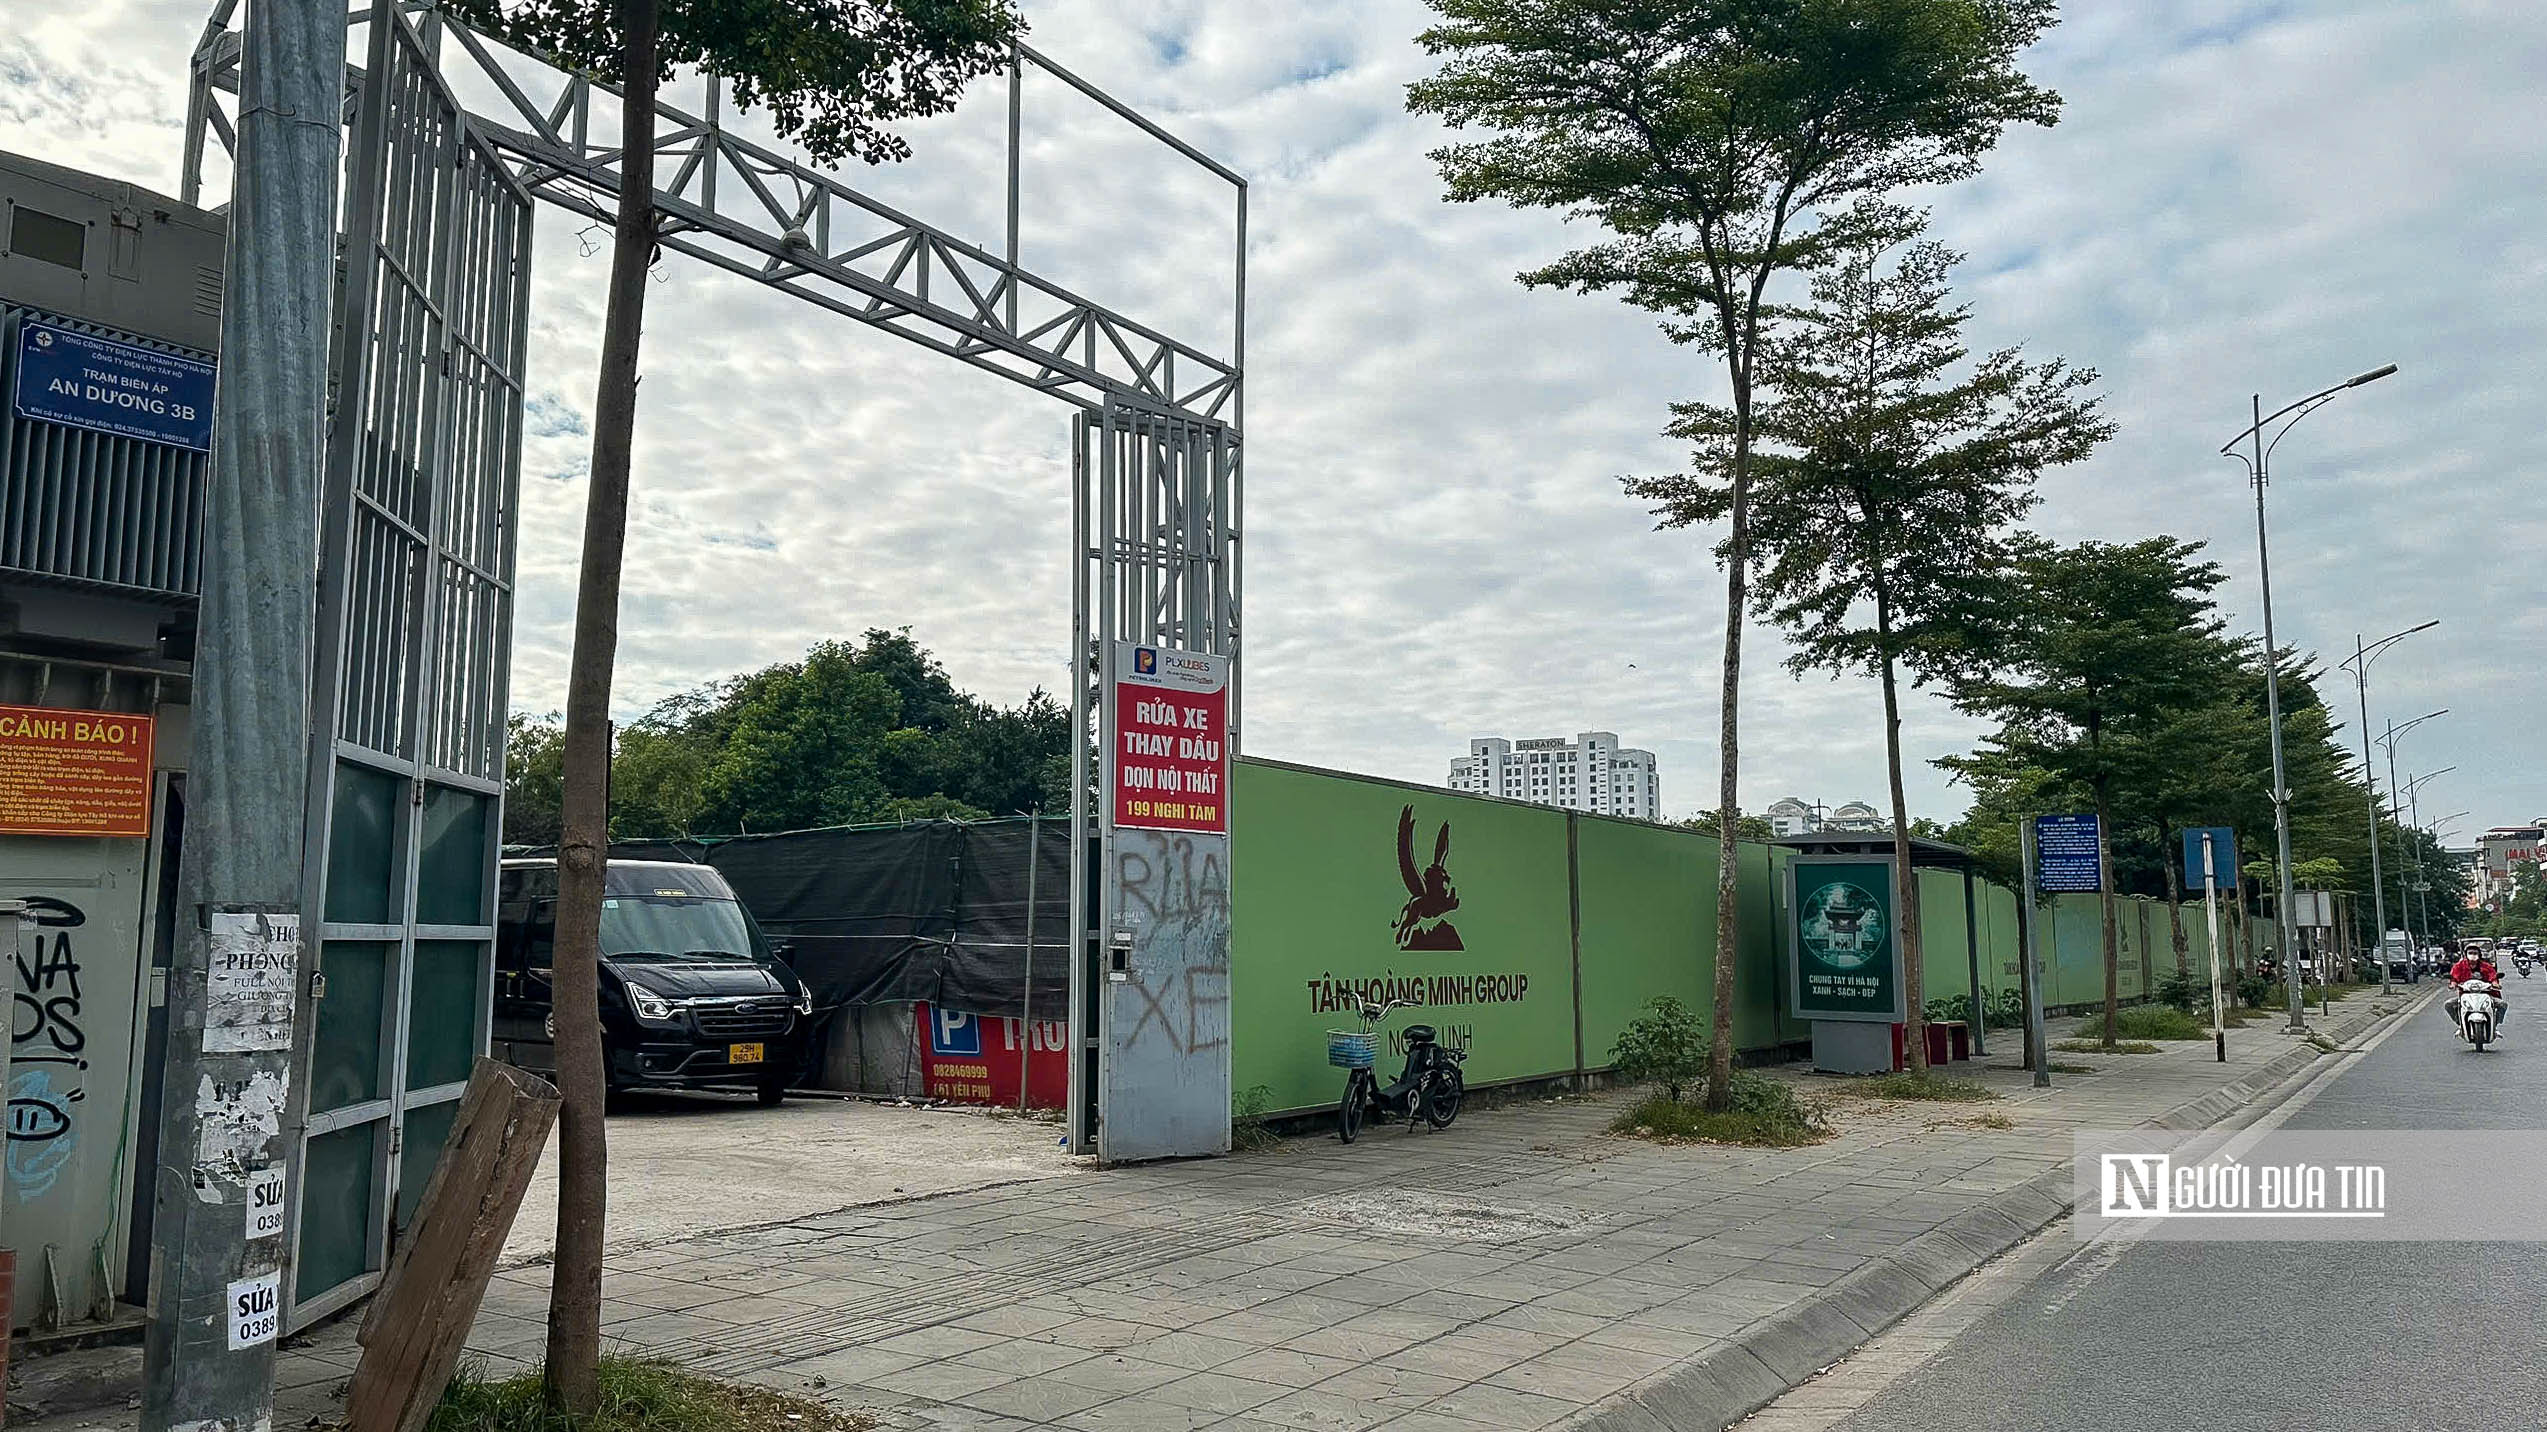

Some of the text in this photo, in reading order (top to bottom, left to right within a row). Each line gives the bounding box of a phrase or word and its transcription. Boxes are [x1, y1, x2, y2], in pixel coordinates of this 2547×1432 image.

[83, 367, 118, 385] TRẠM
[152, 381, 169, 395] ÁP
[48, 377, 196, 421] AN DƯƠNG 3B
[0, 714, 67, 741] CẢNH
[74, 718, 125, 745] BÁO
[1136, 697, 1209, 731] RỬA XE
[1124, 731, 1219, 762] THAY DẦU
[1517, 739, 1565, 750] SHERATON
[1124, 765, 1218, 796] DỌN NỘI THẤT
[1126, 799, 1150, 817] 199
[1154, 802, 1185, 820] NGHI
[1307, 967, 1529, 1013] TÂN HOÀNG MINH GROUP
[1808, 974, 1832, 985] CHUNG
[1833, 975, 1846, 985] TAY
[1812, 985, 1832, 995] XANH
[940, 1008, 967, 1045] P
[1441, 1024, 1473, 1052] LINH
[237, 1282, 274, 1318] SỬA
[240, 1314, 275, 1340] 0389
